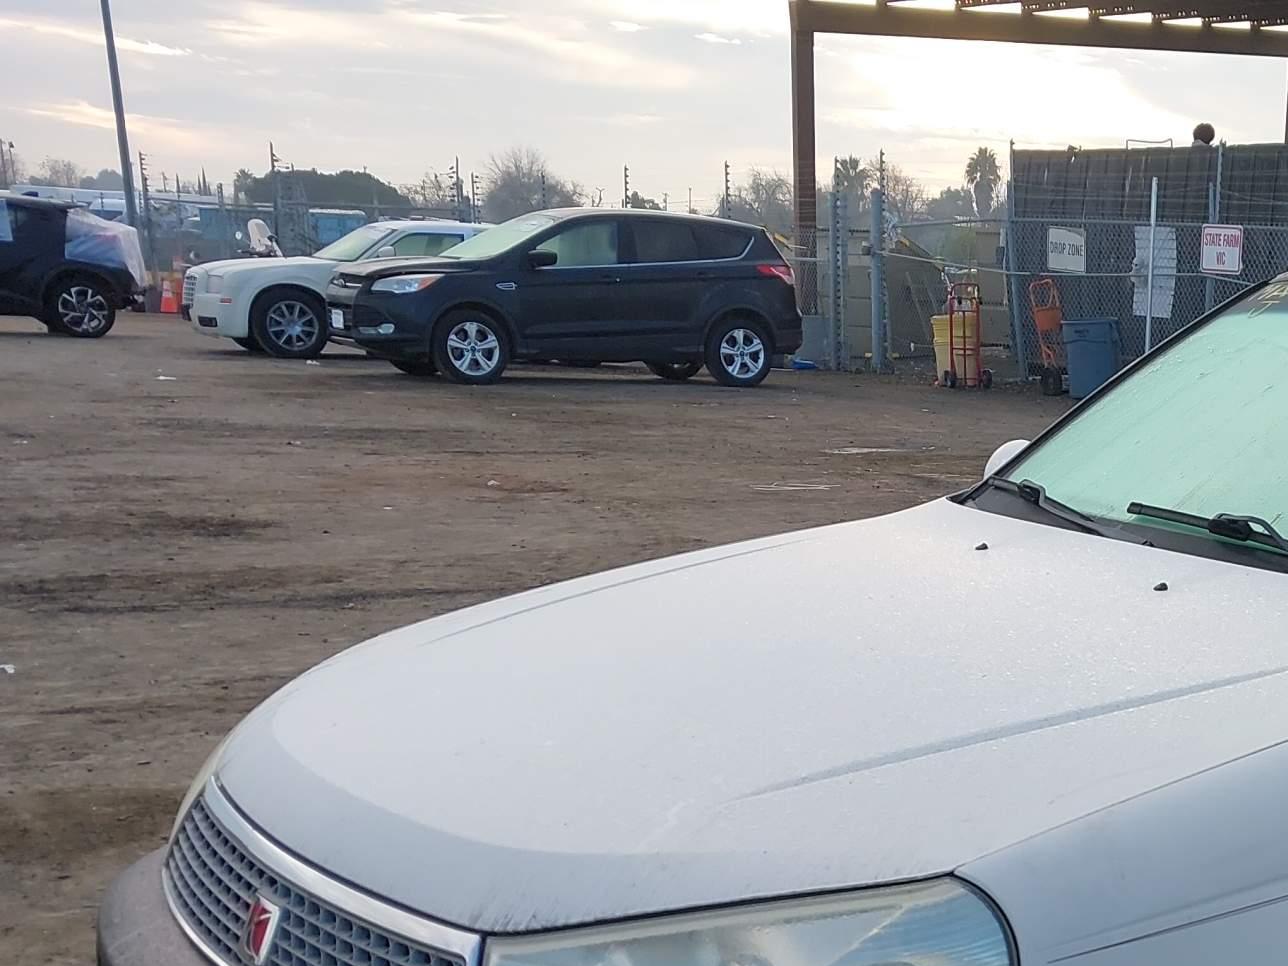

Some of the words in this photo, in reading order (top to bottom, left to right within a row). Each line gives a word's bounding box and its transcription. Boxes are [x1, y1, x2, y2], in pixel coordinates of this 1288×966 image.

[1204, 232, 1222, 247] STATE
[1223, 233, 1240, 248] FARM
[1049, 240, 1066, 254] DROP
[1067, 243, 1083, 257] ZONE
